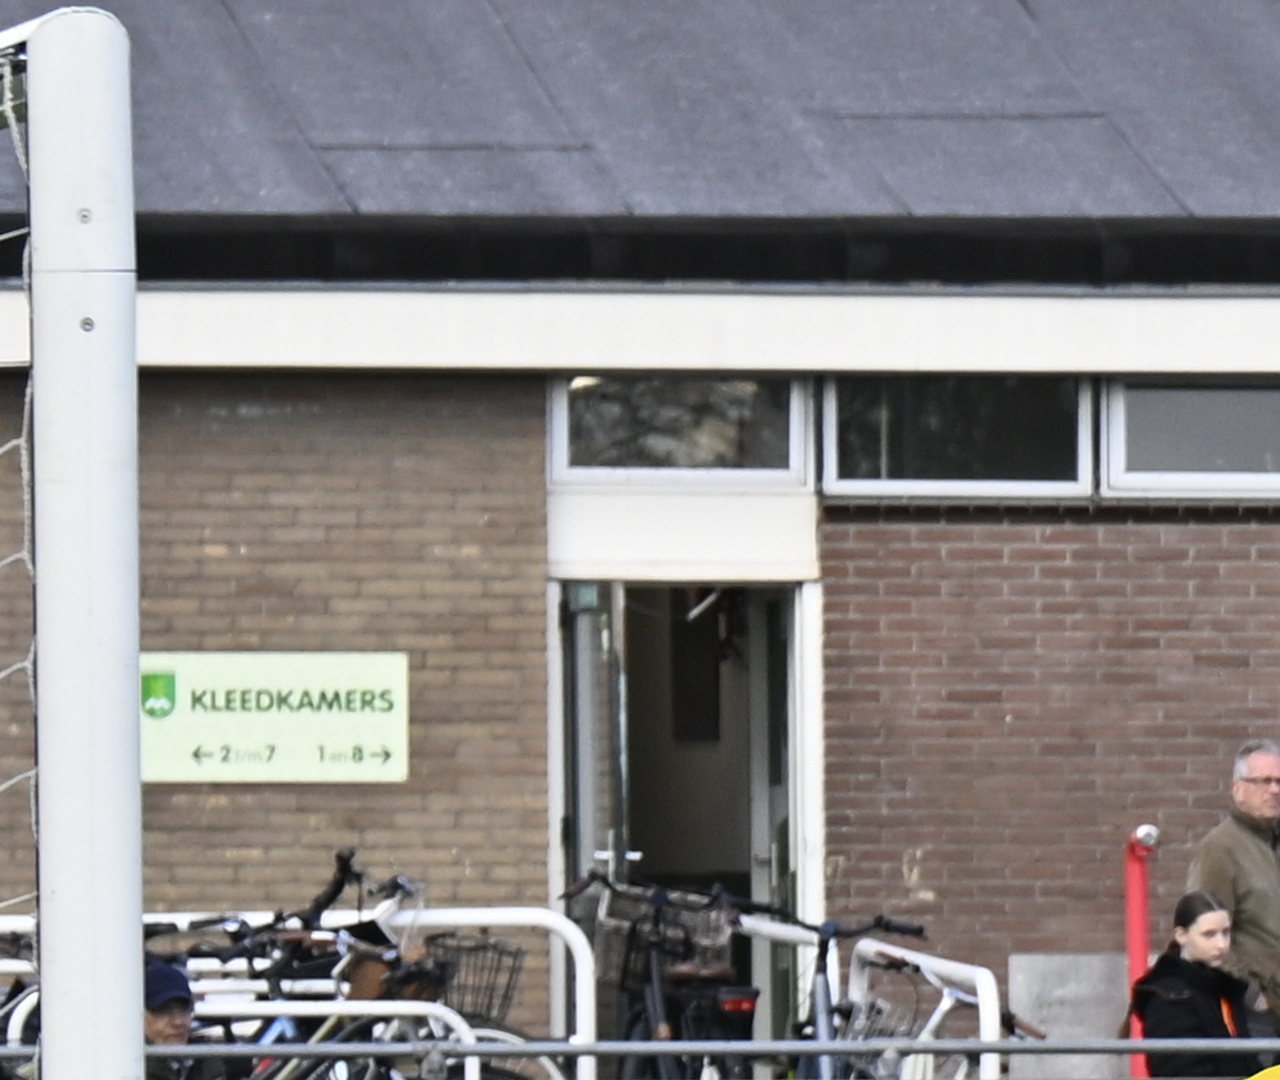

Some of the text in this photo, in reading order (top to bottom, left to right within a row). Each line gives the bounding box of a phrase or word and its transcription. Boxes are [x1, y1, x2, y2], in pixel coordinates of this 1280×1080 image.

[190, 688, 394, 712] KLEEDKAMERS
[219, 744, 231, 763] 2
[265, 744, 276, 763] 7
[351, 744, 364, 764] 8
